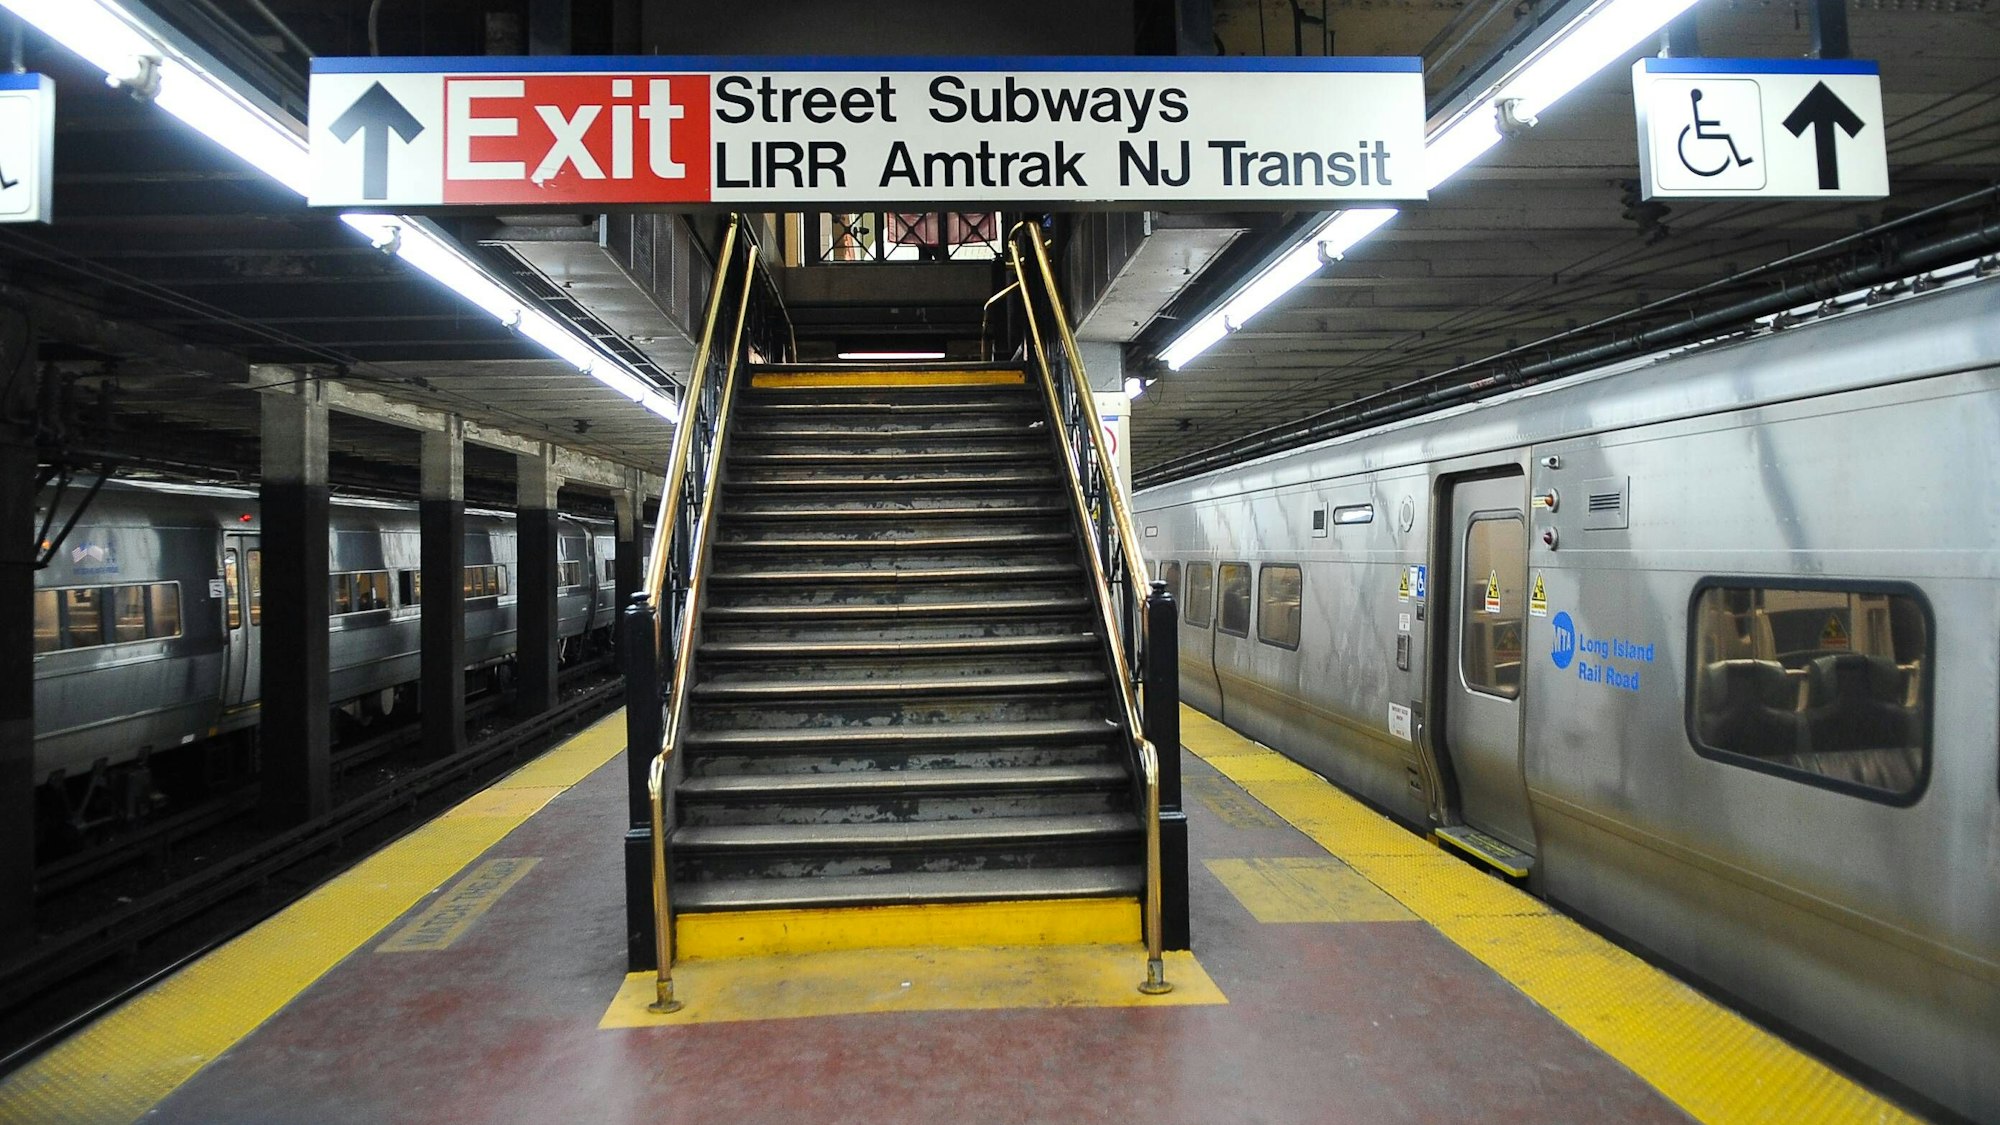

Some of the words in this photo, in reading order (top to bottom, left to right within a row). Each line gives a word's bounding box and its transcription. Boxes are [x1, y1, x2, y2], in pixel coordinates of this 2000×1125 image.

[715, 75, 897, 124] Street
[928, 75, 1189, 134] Subways
[446, 79, 686, 181] Exit
[716, 141, 847, 189] LIRR
[878, 140, 1088, 188] Amtrak
[1119, 140, 1190, 187] NJ
[1207, 140, 1391, 187] Transit
[1579, 633, 1609, 659] Long
[1613, 638, 1655, 662] Island
[1578, 661, 1602, 683] Rail
[1606, 665, 1640, 690] Road
